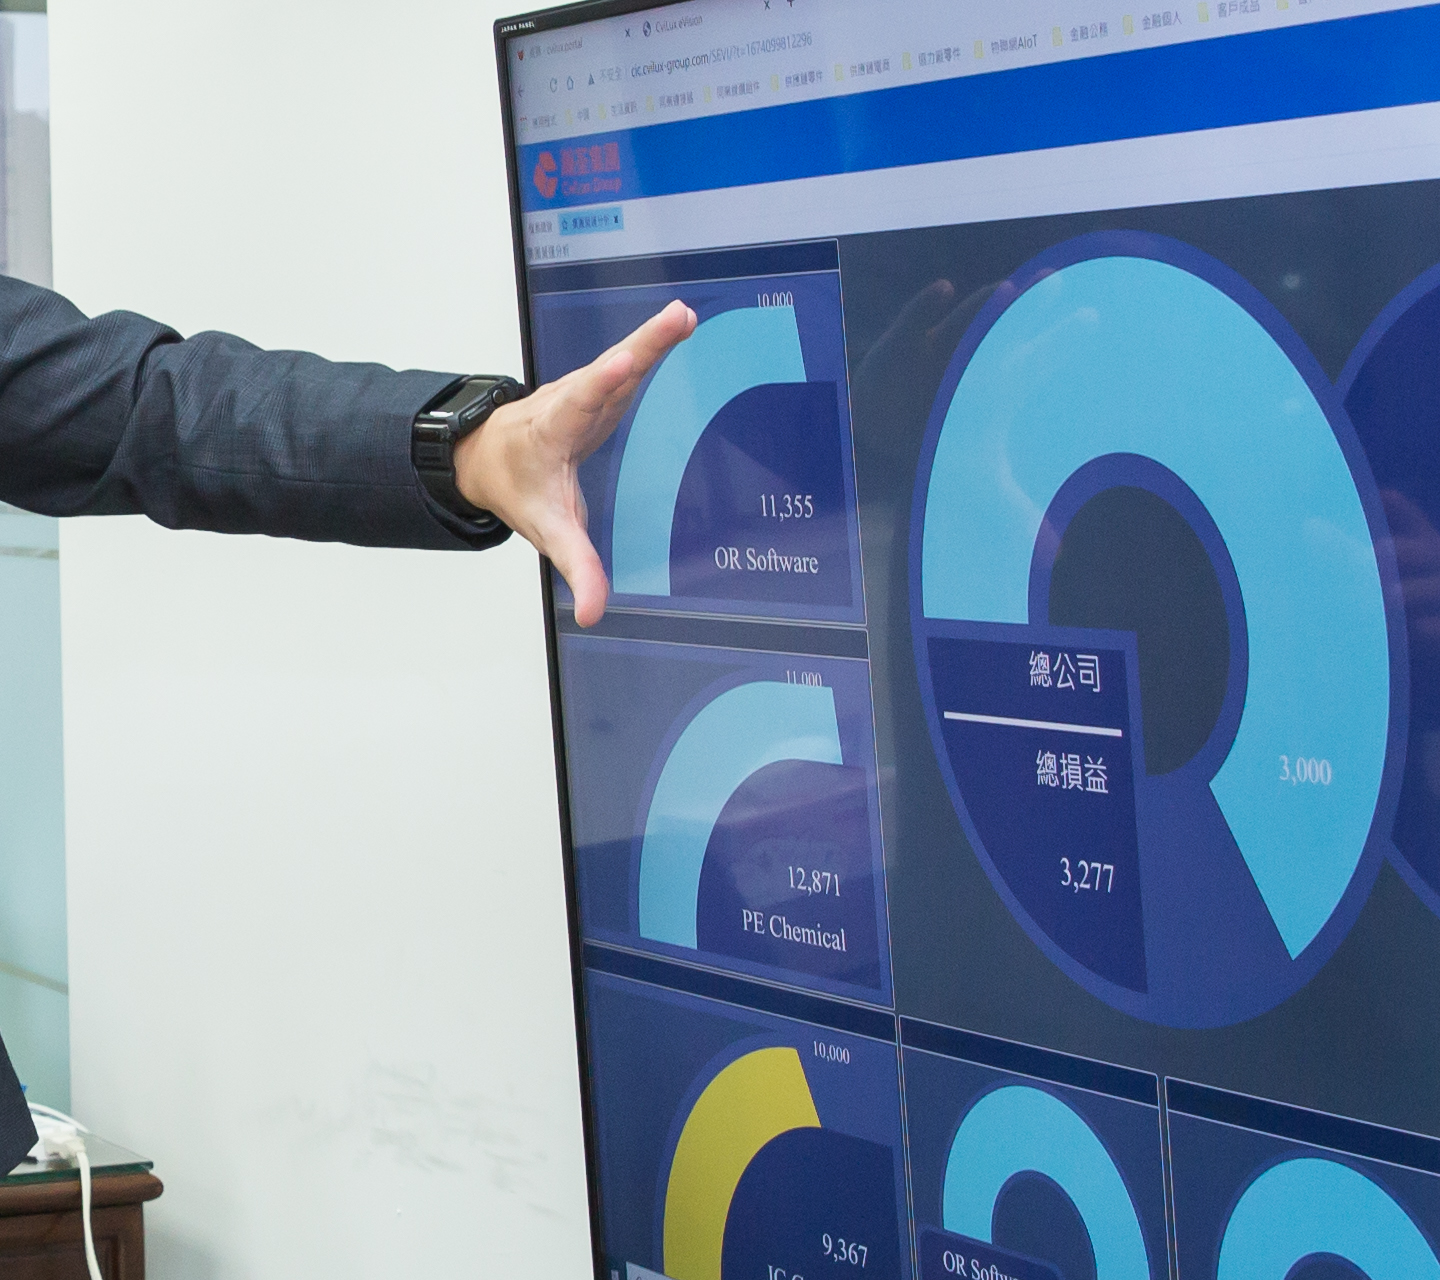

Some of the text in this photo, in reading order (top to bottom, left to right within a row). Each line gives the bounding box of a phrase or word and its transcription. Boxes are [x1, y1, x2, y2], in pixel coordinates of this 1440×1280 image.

[760, 494, 814, 522] 11,355
[714, 546, 819, 574] OR Software
[1028, 650, 1101, 693] 總公司
[1035, 749, 1109, 794] 總損益
[1279, 755, 1333, 787] 3,000
[788, 866, 841, 897] 12,871
[1059, 857, 1114, 893] 3,277
[742, 908, 847, 952] PE Chemical
[813, 1040, 850, 1065] 10,000
[822, 1233, 869, 1269] 9,367
[942, 1250, 967, 1278] OR
